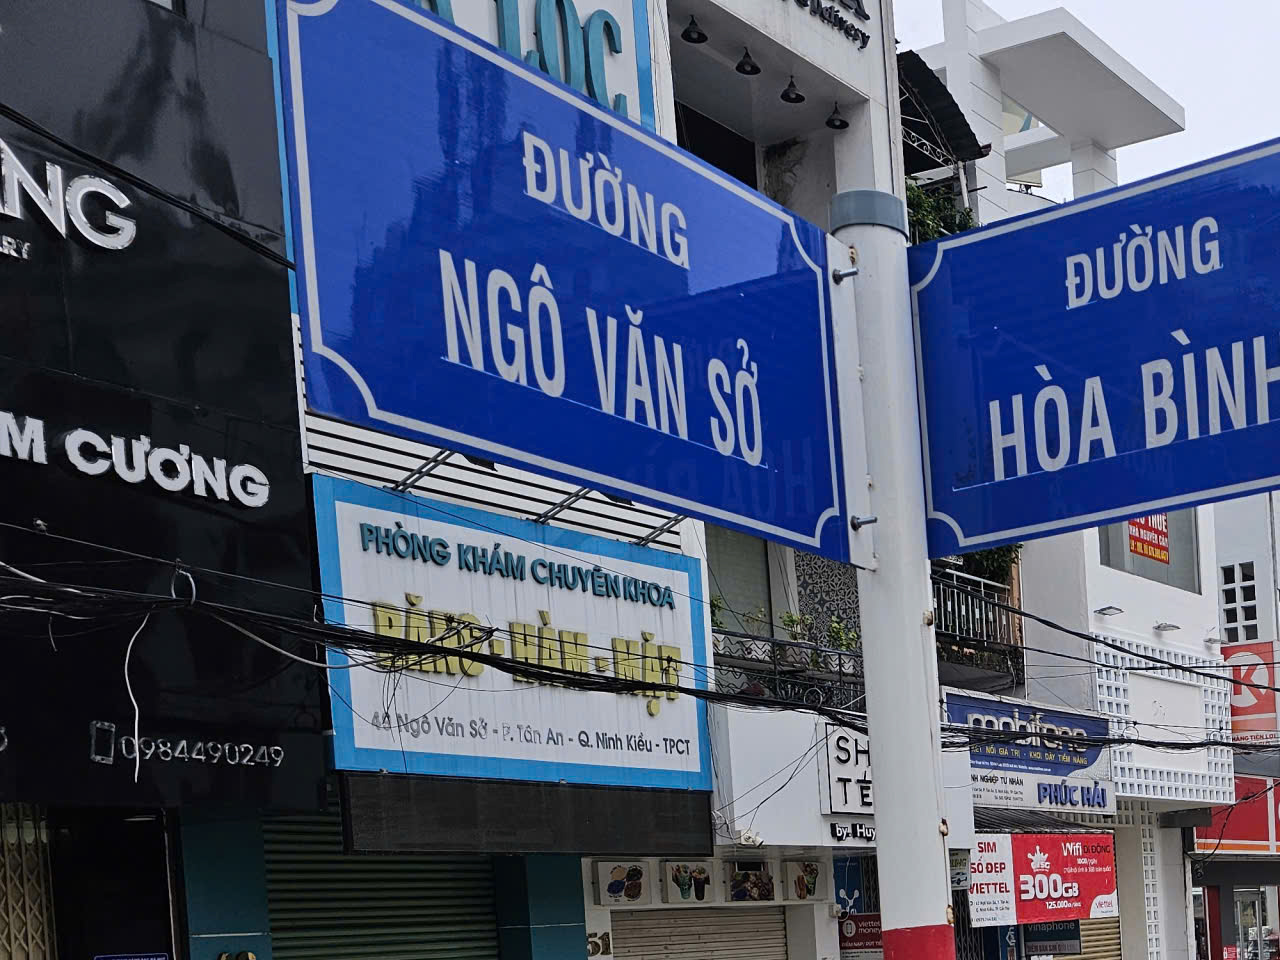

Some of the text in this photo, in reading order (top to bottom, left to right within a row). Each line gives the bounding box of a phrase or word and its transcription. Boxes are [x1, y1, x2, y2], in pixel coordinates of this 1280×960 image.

[522, 131, 690, 271] ĐƯỜNG
[1065, 216, 1223, 309] ĐƯỜNG
[440, 249, 764, 467] NGÔ VĂN SỞ
[989, 364, 1117, 481] HÒA
[65, 428, 270, 507] CƯƠNG
[360, 521, 676, 610] PHÒNG KHÁM CHUYÊN KHOA
[120, 735, 285, 767] 0984490249
[434, 716, 465, 738] Văn
[469, 715, 488, 740] Sở
[518, 724, 542, 746] Tân
[546, 728, 564, 747] An
[577, 731, 594, 750] Q.
[596, 732, 623, 752] Ninh
[626, 731, 652, 754] Kiều
[663, 740, 691, 756] TPCT
[1036, 778, 1107, 809] PHÚC HẢI
[977, 841, 997, 853] SIM
[1061, 842, 1083, 857] Wifi
[970, 856, 984, 874] SỐ
[985, 862, 1006, 876] ĐẸP
[969, 882, 1010, 895] VIETTEL
[1019, 873, 1079, 900] 300GB
[1028, 919, 1076, 933] vinaphone
[587, 932, 612, 957] 51
